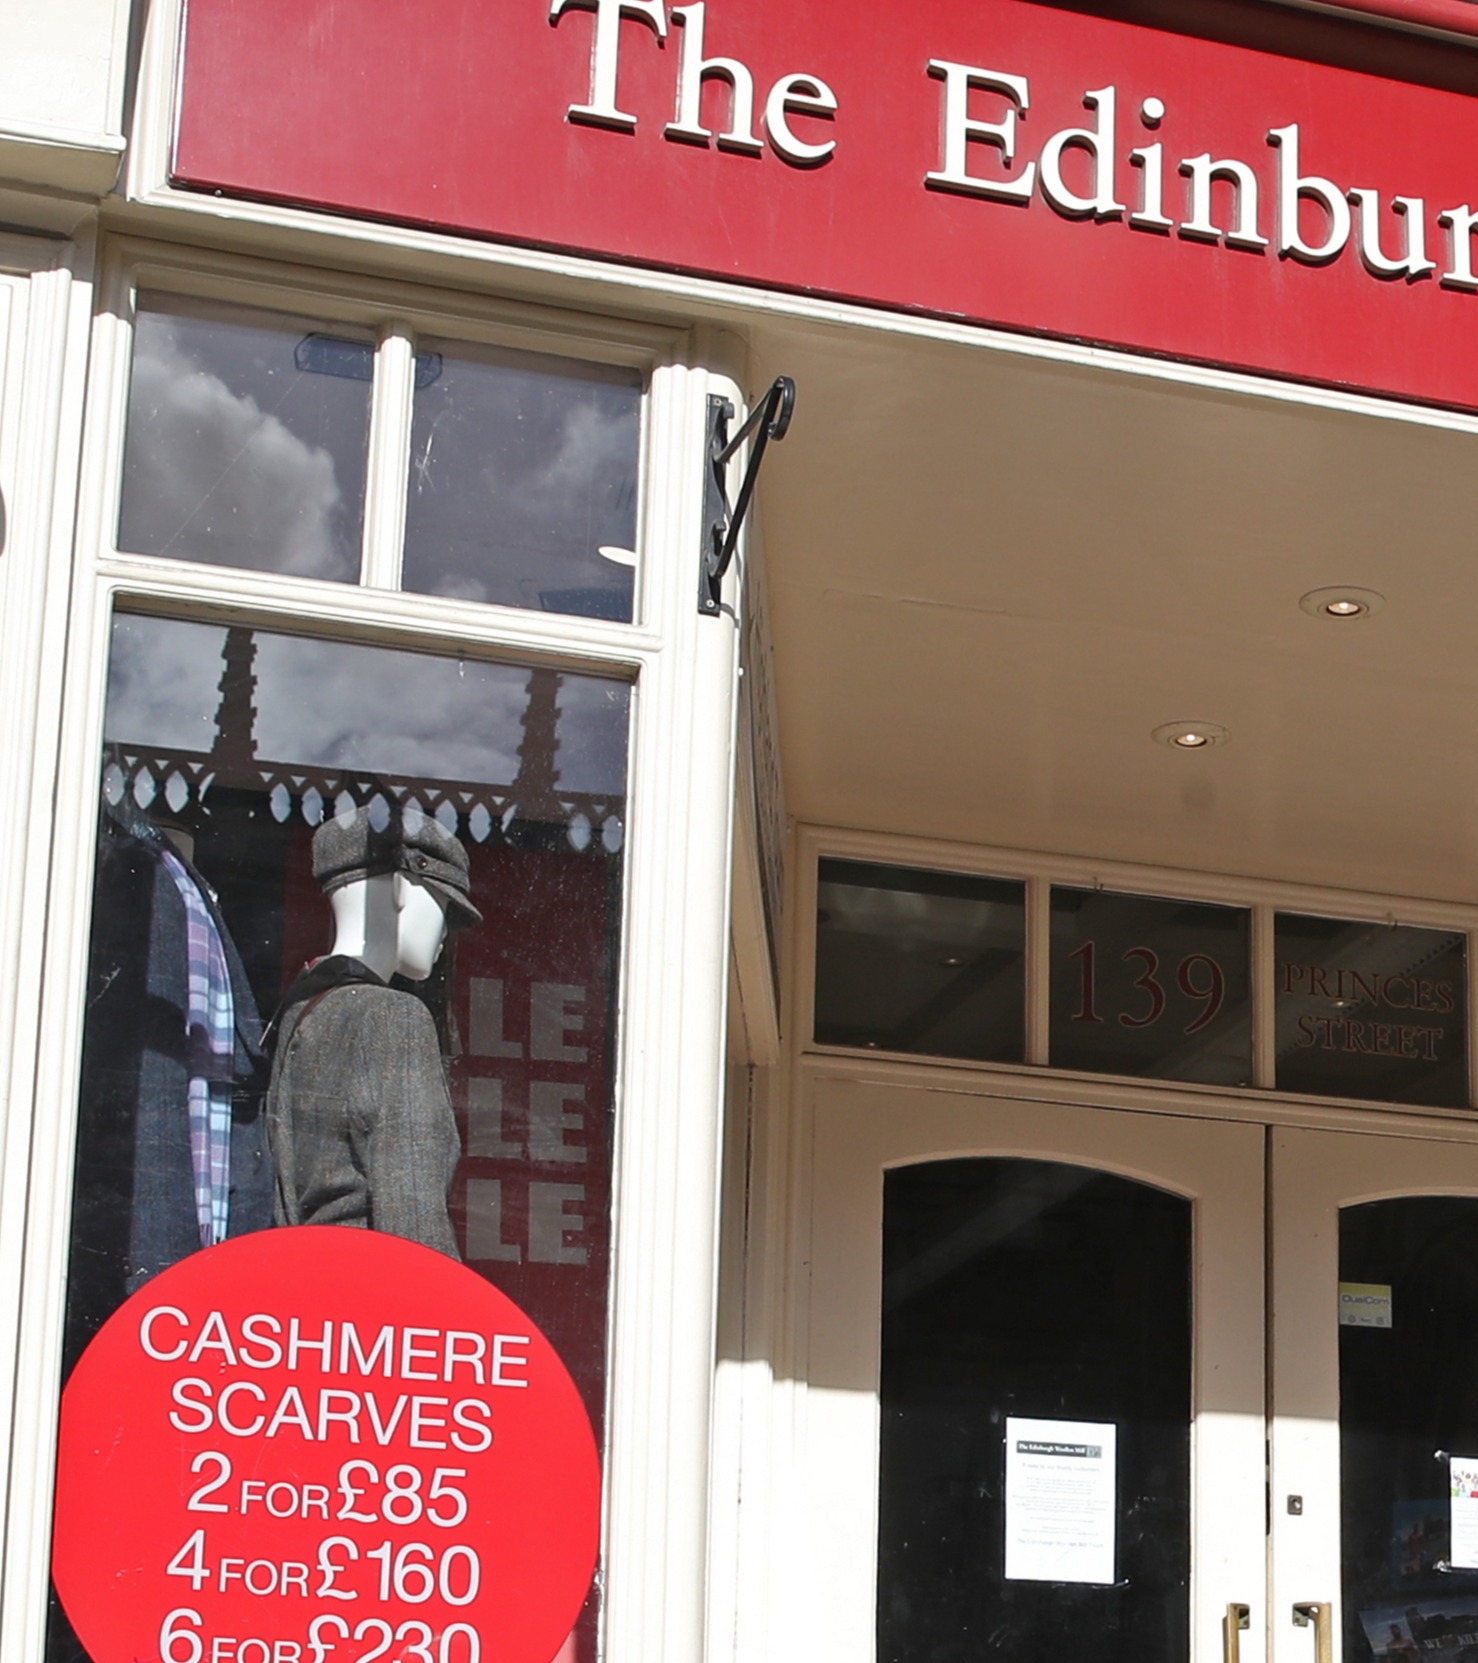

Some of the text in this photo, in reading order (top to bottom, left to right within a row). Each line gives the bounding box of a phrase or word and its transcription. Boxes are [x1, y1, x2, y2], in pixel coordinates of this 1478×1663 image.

[549, 0, 838, 166] The
[1069, 940, 1225, 1035] 139
[1281, 962, 1455, 1014] PRINCES
[1297, 1014, 1444, 1062] STREET
[139, 1305, 531, 1388] CASHMERE
[168, 1377, 494, 1453] SCARVES
